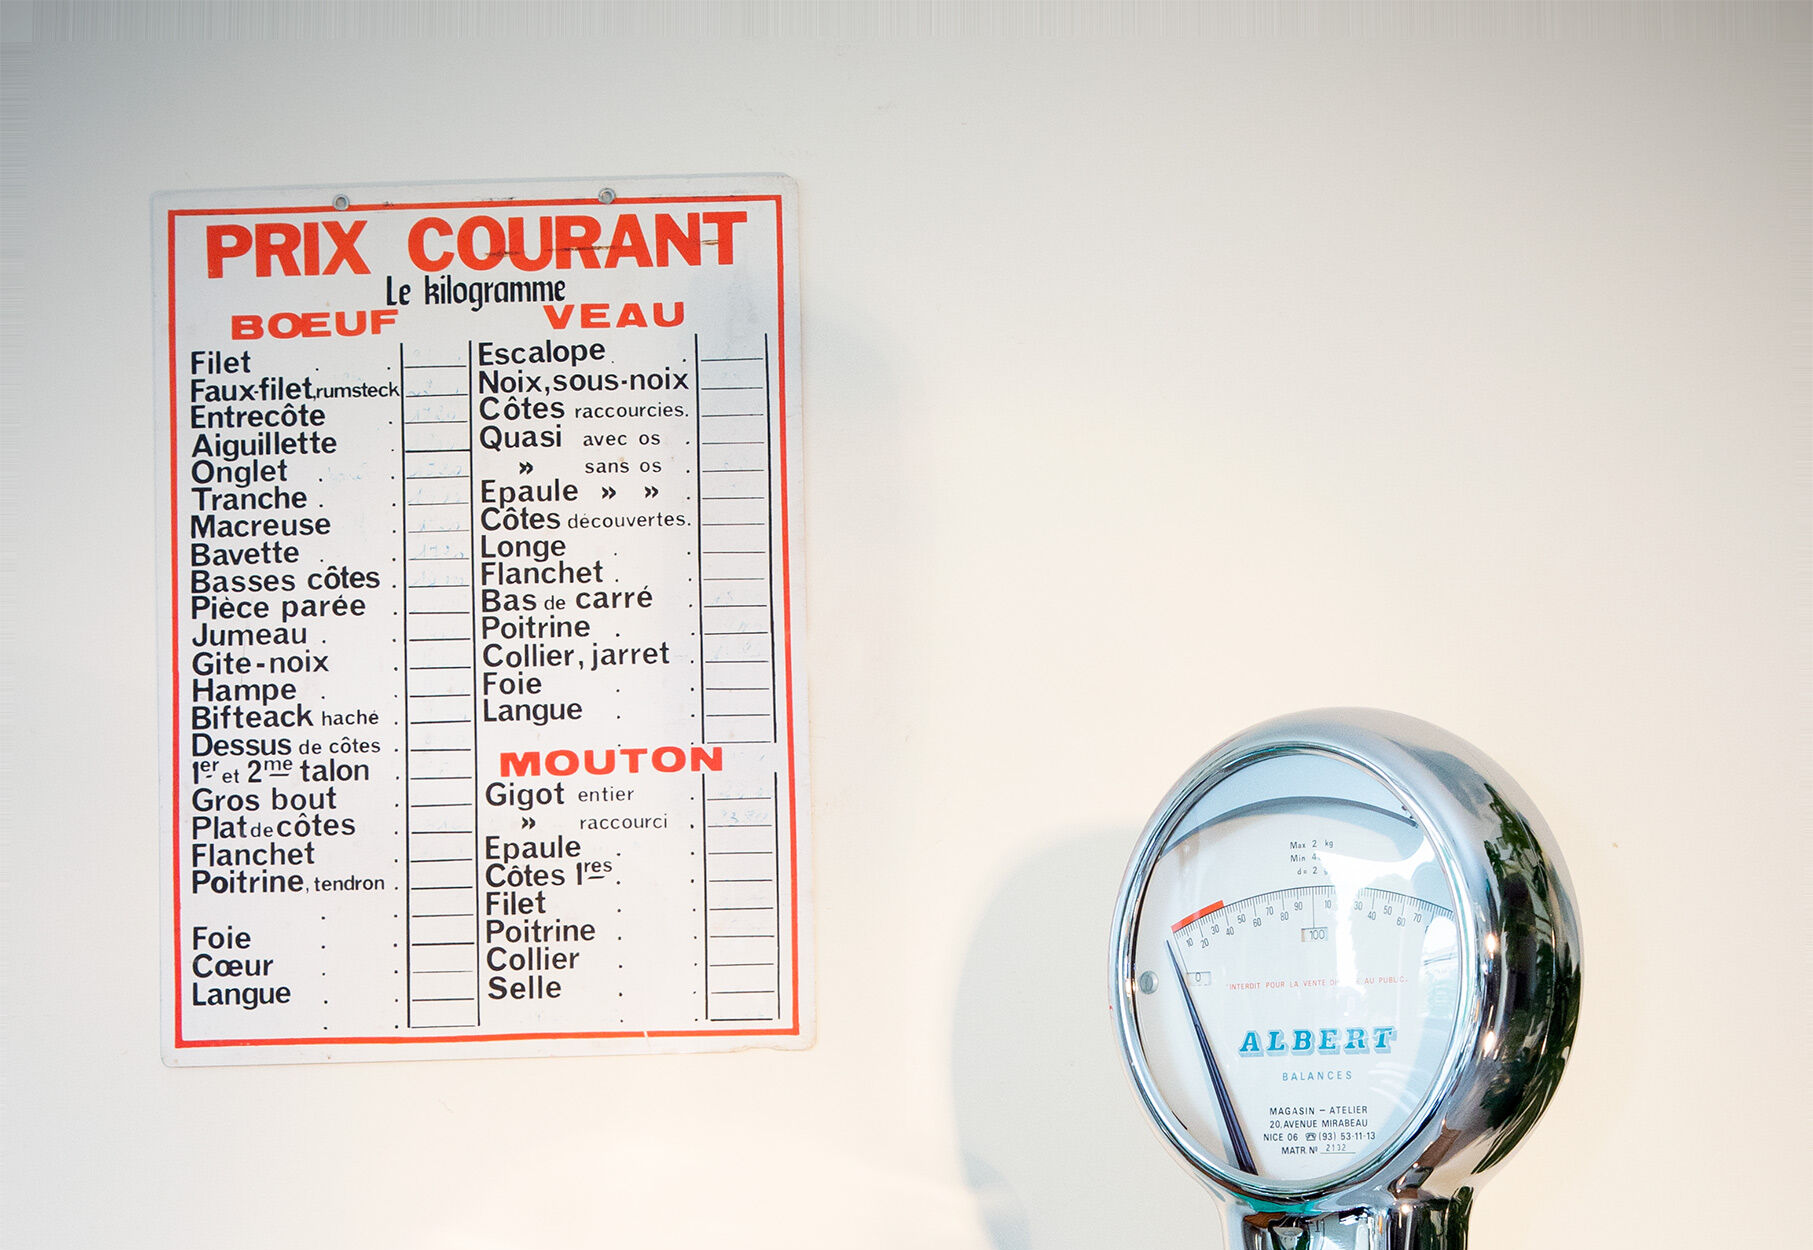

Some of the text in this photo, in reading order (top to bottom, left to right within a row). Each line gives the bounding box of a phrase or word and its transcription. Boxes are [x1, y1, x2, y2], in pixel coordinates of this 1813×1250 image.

[206, 210, 748, 279] PRIX COURANT
[386, 274, 566, 313] Le kilogramme
[542, 301, 685, 330] VEAU
[190, 350, 251, 375] Filet
[478, 339, 606, 367] Escalope
[190, 402, 326, 429] Entrecôte
[479, 395, 565, 421] Côtes
[191, 430, 337, 462] Aiguillette
[479, 423, 661, 452] Quasi avec os
[191, 458, 288, 489] Onglet
[585, 461, 630, 474] sans
[639, 461, 662, 473] os
[191, 485, 308, 511] Tranche
[481, 479, 578, 508] Epaule
[190, 514, 331, 539] Macreuse
[480, 506, 561, 532] Côtes
[190, 540, 300, 567] Bavette
[481, 534, 566, 563] Longe
[190, 565, 381, 594] Basses côtes
[481, 560, 604, 586] Flanchet
[191, 594, 366, 623] Pièce parée
[481, 585, 653, 613] Bas de carré
[192, 622, 307, 647] Jumeau
[481, 614, 591, 640] Poitrine
[482, 641, 670, 672] Collier, jarret
[192, 677, 297, 707] Hampe
[483, 670, 542, 696] Foie
[191, 702, 314, 730] Bifteack
[483, 698, 583, 727] Langue
[192, 732, 381, 757] Dessus de côtes
[222, 769, 240, 784] et
[299, 758, 369, 783] talon
[500, 746, 723, 778] MOUTON
[191, 786, 337, 812] Gros bout
[485, 781, 634, 811] Gigot entier
[192, 812, 356, 840] Plat de côtes
[580, 817, 667, 830] raccourci
[192, 841, 315, 868] Flanchet
[485, 834, 581, 864] Epaule
[1325, 840, 1333, 848] kg
[313, 874, 385, 892] tendron
[485, 862, 566, 888] Côtes
[1313, 866, 1318, 874] 2
[486, 890, 546, 916] Filet
[1325, 900, 1331, 909] 10
[1186, 902, 1303, 948] 10 20 30 40 50 60 70 80 90
[1368, 911, 1376, 920] 40
[1384, 906, 1392, 915] 50
[1397, 917, 1406, 927] 60
[1413, 913, 1421, 923] 70
[192, 925, 251, 951] Foie
[486, 918, 596, 944] Poitrine
[1310, 930, 1325, 940] 100
[192, 953, 274, 979] Cœur
[486, 946, 580, 972] Collier
[192, 982, 291, 1011] Langue
[487, 975, 562, 1000] Selle
[1238, 1026, 1397, 1057] ALBERT
[1283, 1071, 1352, 1081] BALANCES
[1270, 1107, 1315, 1115] MAGASIN
[1330, 1106, 1367, 1114] ATELIER
[1322, 1119, 1367, 1127] MIRABEAU
[1264, 1133, 1283, 1141] NICE
[1287, 1133, 1298, 1141] 06
[1319, 1132, 1336, 1141] (93)
